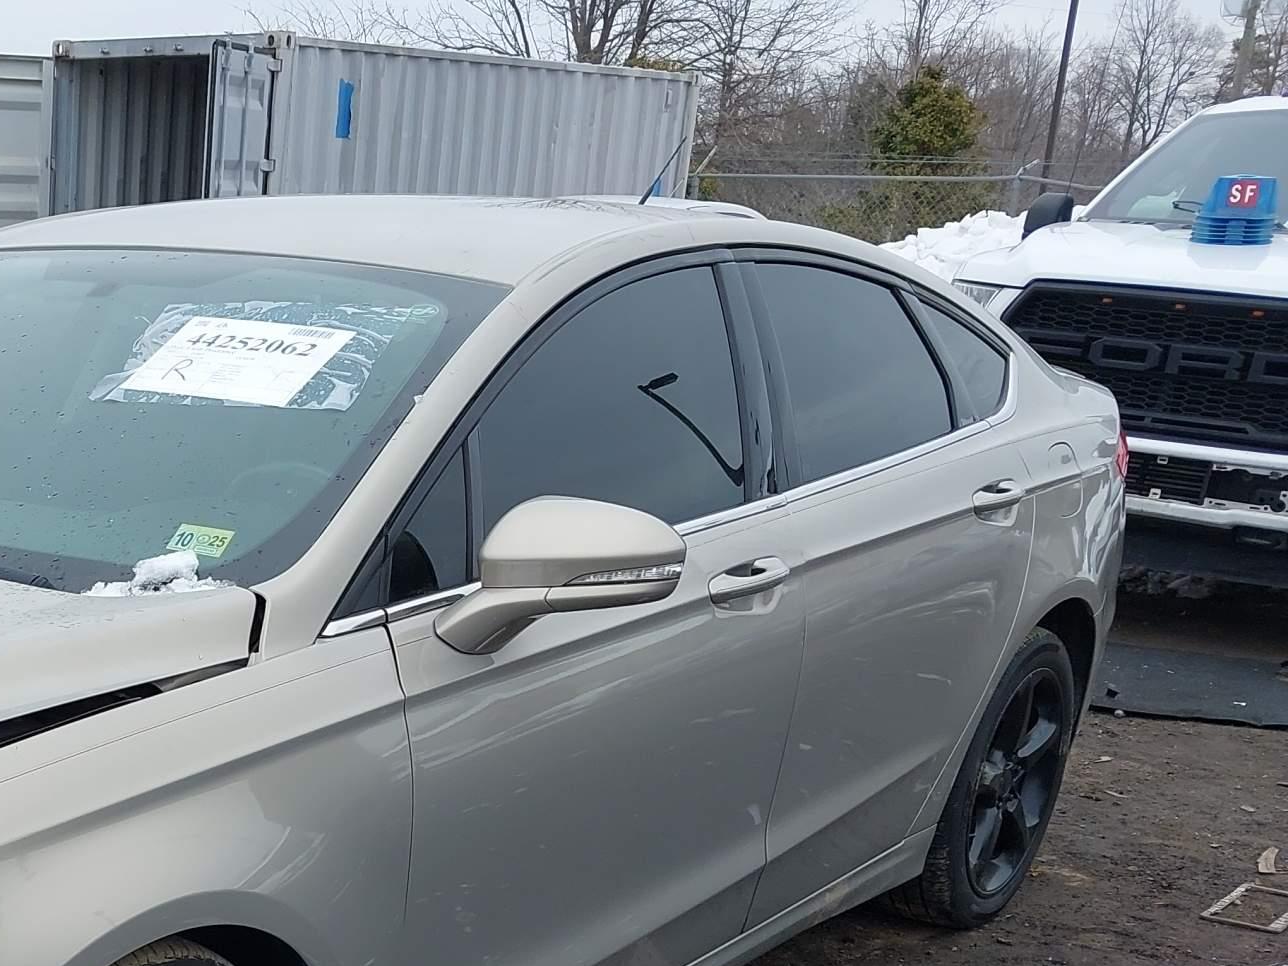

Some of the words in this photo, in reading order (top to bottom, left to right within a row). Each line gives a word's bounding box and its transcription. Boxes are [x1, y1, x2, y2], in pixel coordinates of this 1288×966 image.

[187, 333, 318, 357] 44252062
[162, 359, 193, 381] R
[175, 531, 194, 547] 10
[208, 535, 228, 548] 25
